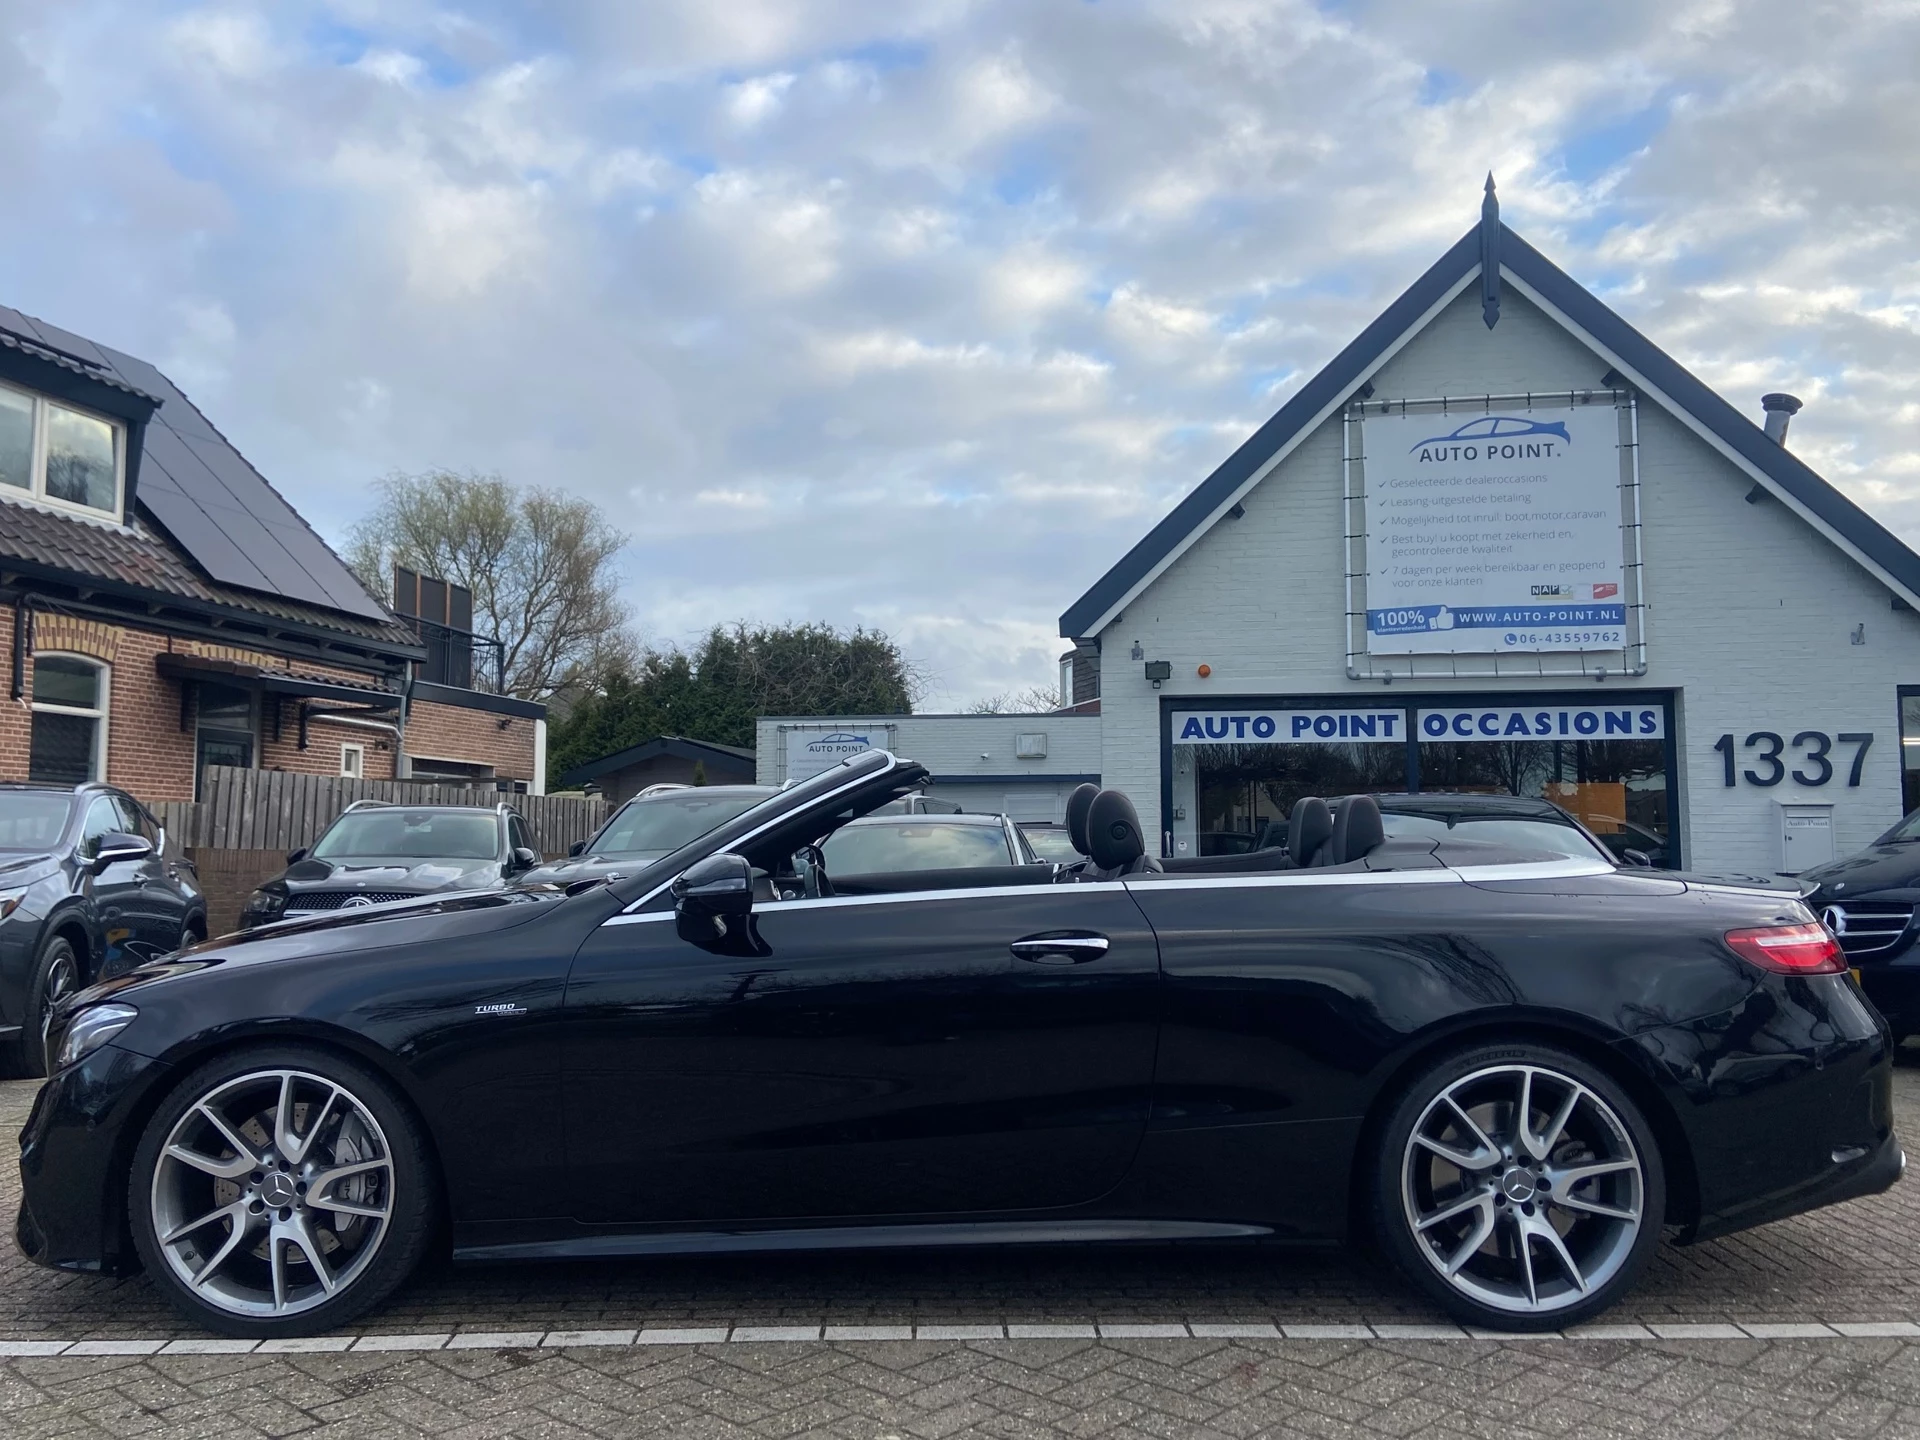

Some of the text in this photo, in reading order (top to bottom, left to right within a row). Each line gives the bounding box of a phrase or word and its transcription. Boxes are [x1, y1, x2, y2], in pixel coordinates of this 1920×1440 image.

[1420, 443, 1561, 462] AUTO POINT.
[1390, 475, 1548, 488] Geselecteerde dealeroccasions
[1391, 493, 1532, 507] Leasing-uitgestelde betaling
[1391, 515, 1454, 527] Mogelijkheid
[1457, 513, 1471, 523] tot
[1392, 535, 1414, 544] Best
[1440, 535, 1447, 543] u
[1450, 533, 1480, 544] koopt
[1482, 532, 1502, 541] met
[1505, 530, 1555, 541] zekerheid
[1392, 544, 1513, 559] gecontroleerde kwaliteit
[1393, 560, 1606, 577] 7 dagen per week bereikbaar en geopend
[1392, 577, 1483, 588] voor onze klanten
[1531, 585, 1559, 595] NAP
[1377, 610, 1619, 626] 100% WWW.AUTO-POINT.NL
[1520, 632, 1620, 643] 06-43559762
[1180, 710, 1657, 739] AUTO POINT OCCASIONS
[809, 745, 833, 753] AUTO
[1714, 731, 1874, 787] 1337
[474, 1003, 516, 1012] TURBO
